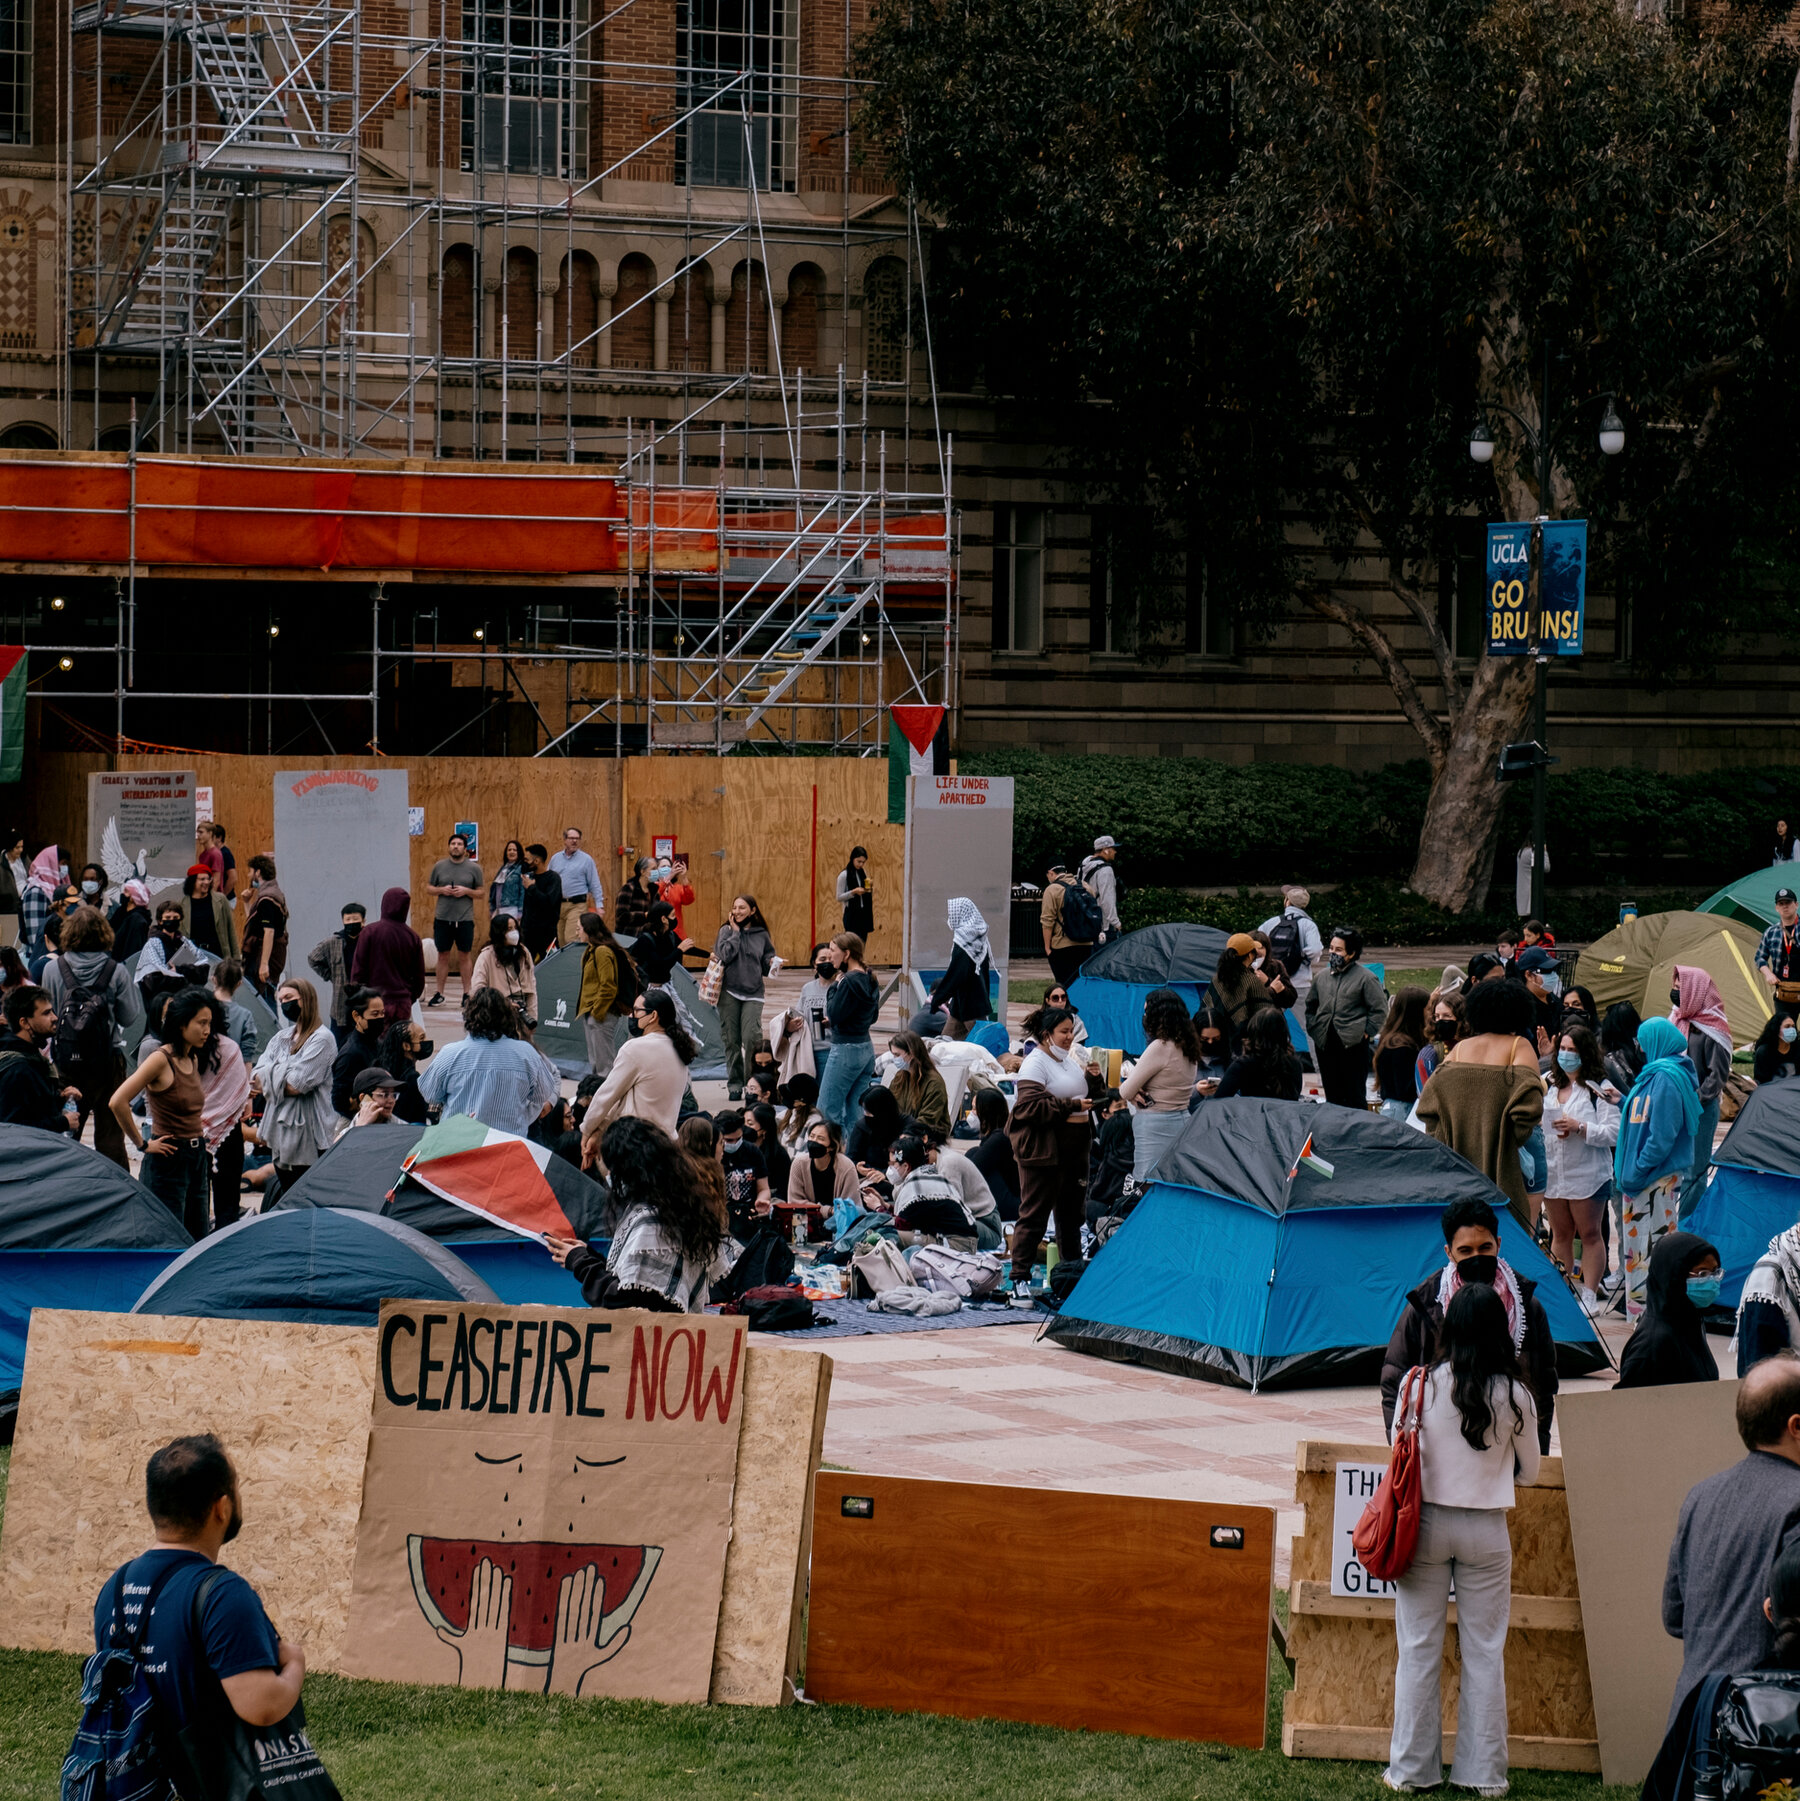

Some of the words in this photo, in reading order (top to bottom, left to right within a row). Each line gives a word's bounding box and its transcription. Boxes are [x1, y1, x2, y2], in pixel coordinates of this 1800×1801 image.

[1492, 543, 1528, 564] UCLA
[1491, 579, 1524, 609] GO
[936, 777, 958, 789] LIFE
[961, 778, 990, 790] UNDER
[939, 792, 987, 805] APARTHEID
[381, 1312, 612, 1417] CEASEFIRE
[625, 1325, 743, 1424] NOW
